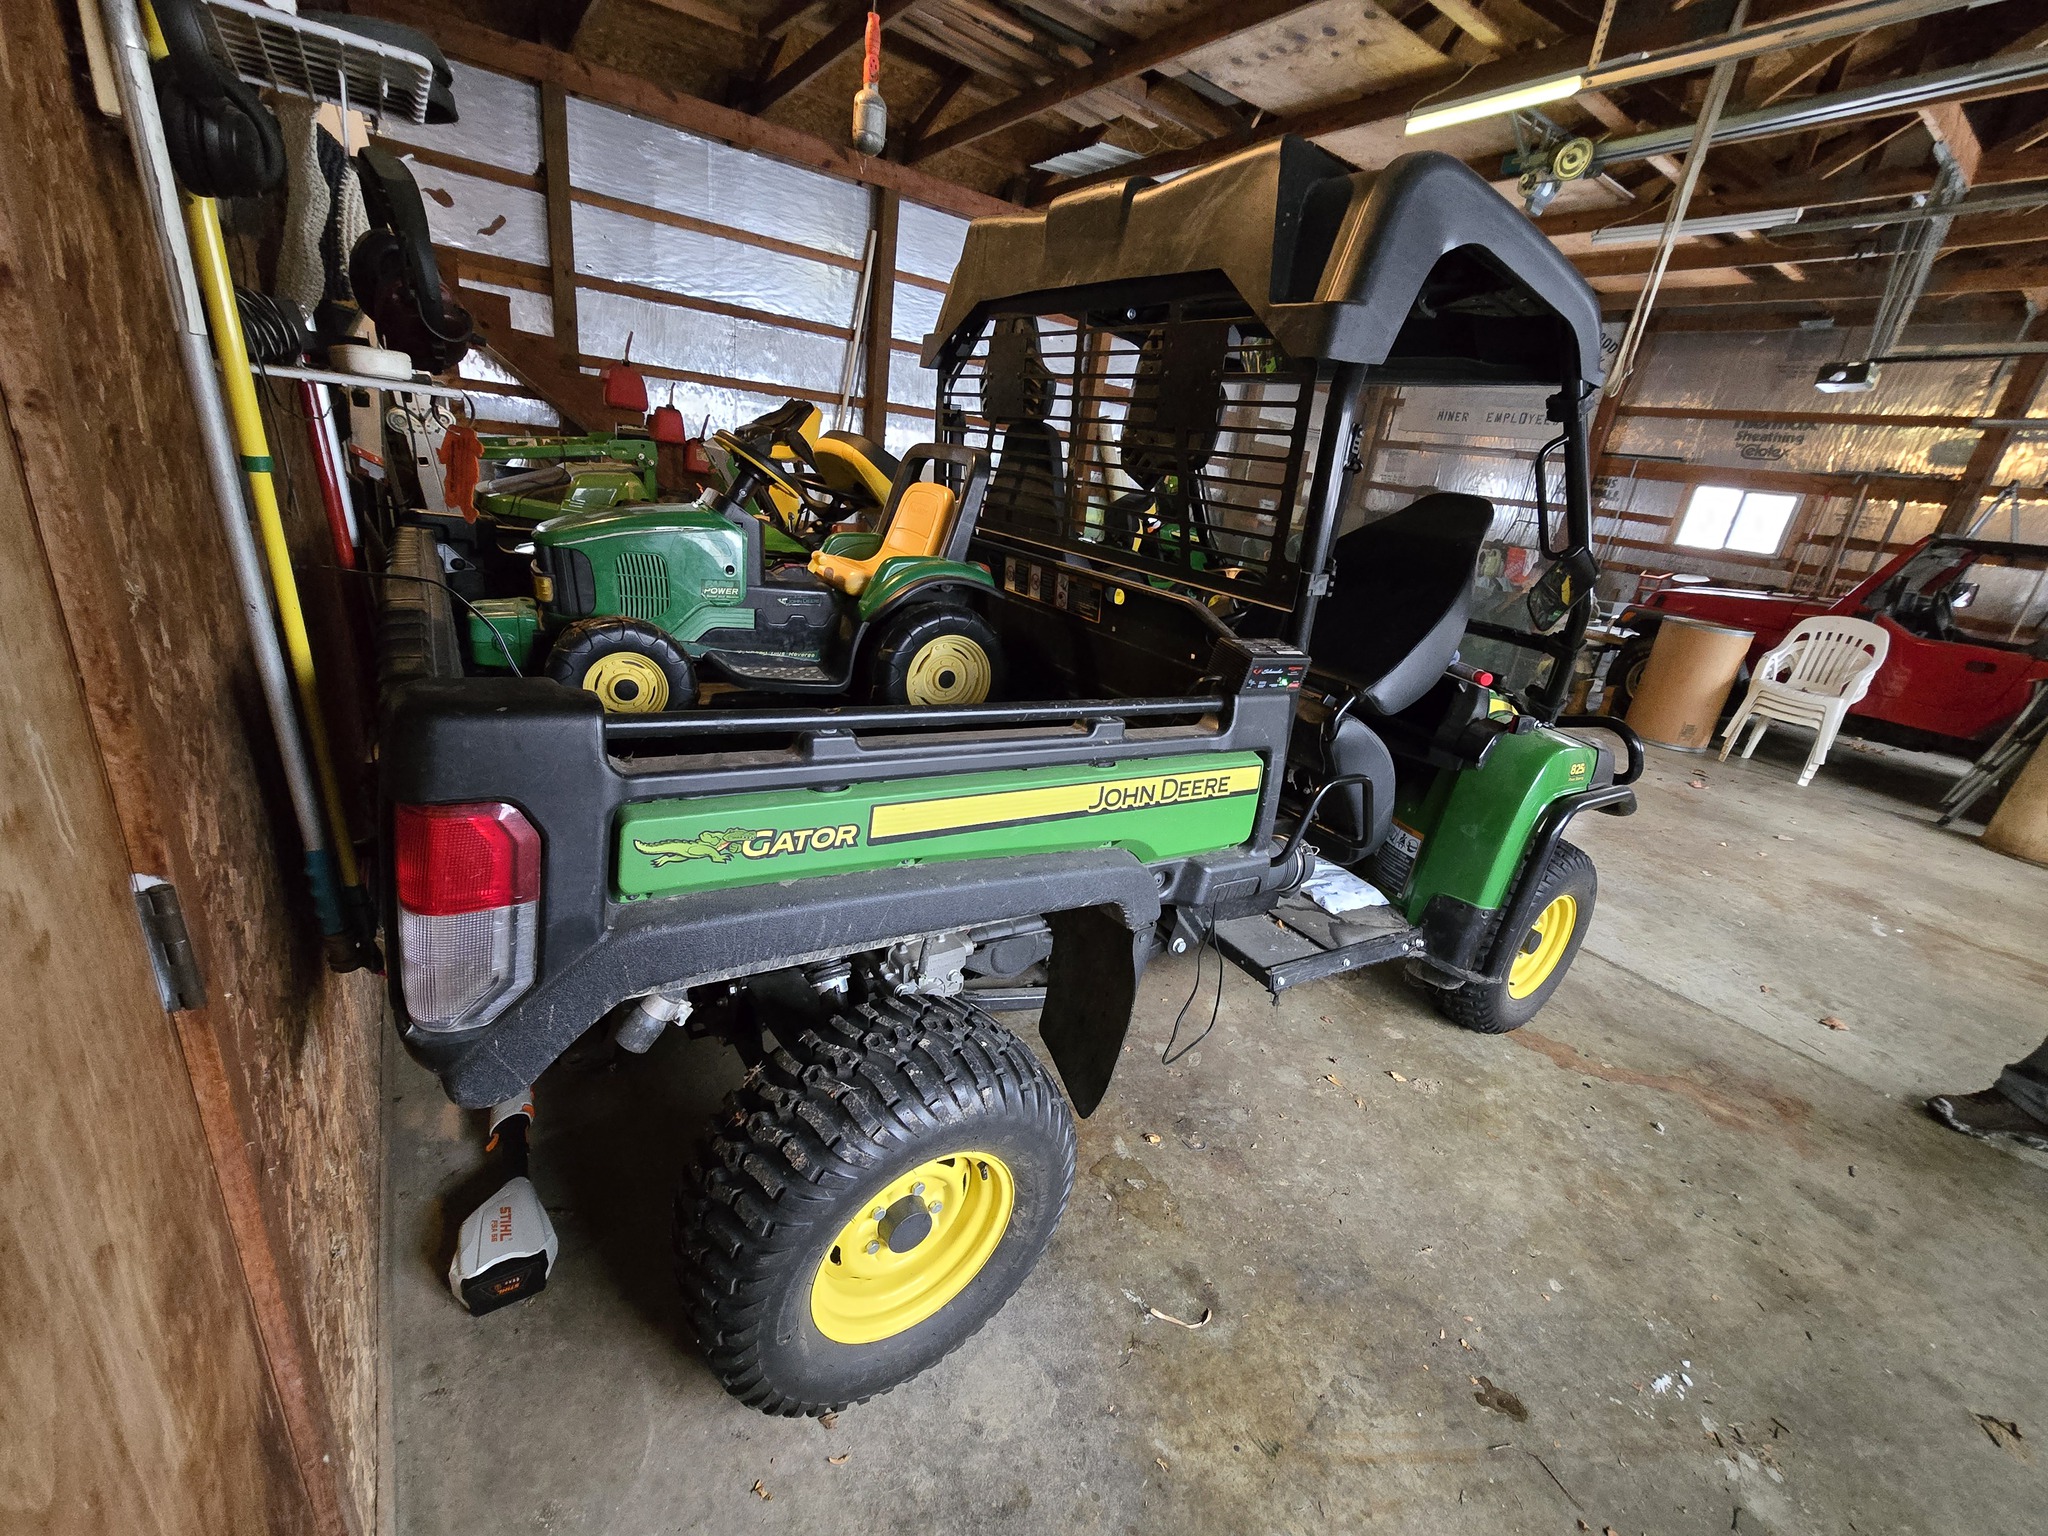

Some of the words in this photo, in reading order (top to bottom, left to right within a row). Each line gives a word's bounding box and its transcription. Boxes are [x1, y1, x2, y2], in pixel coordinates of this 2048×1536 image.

[1436, 409, 1470, 422] HINER
[1486, 412, 1559, 426] EMPLOYEE
[1734, 431, 1805, 445] Sheathing
[703, 587, 739, 595] POWER
[1088, 785, 1156, 810] JOHN
[1160, 776, 1231, 801] DEERE
[741, 824, 859, 860] GATOR
[500, 1206, 512, 1242] STIHL
